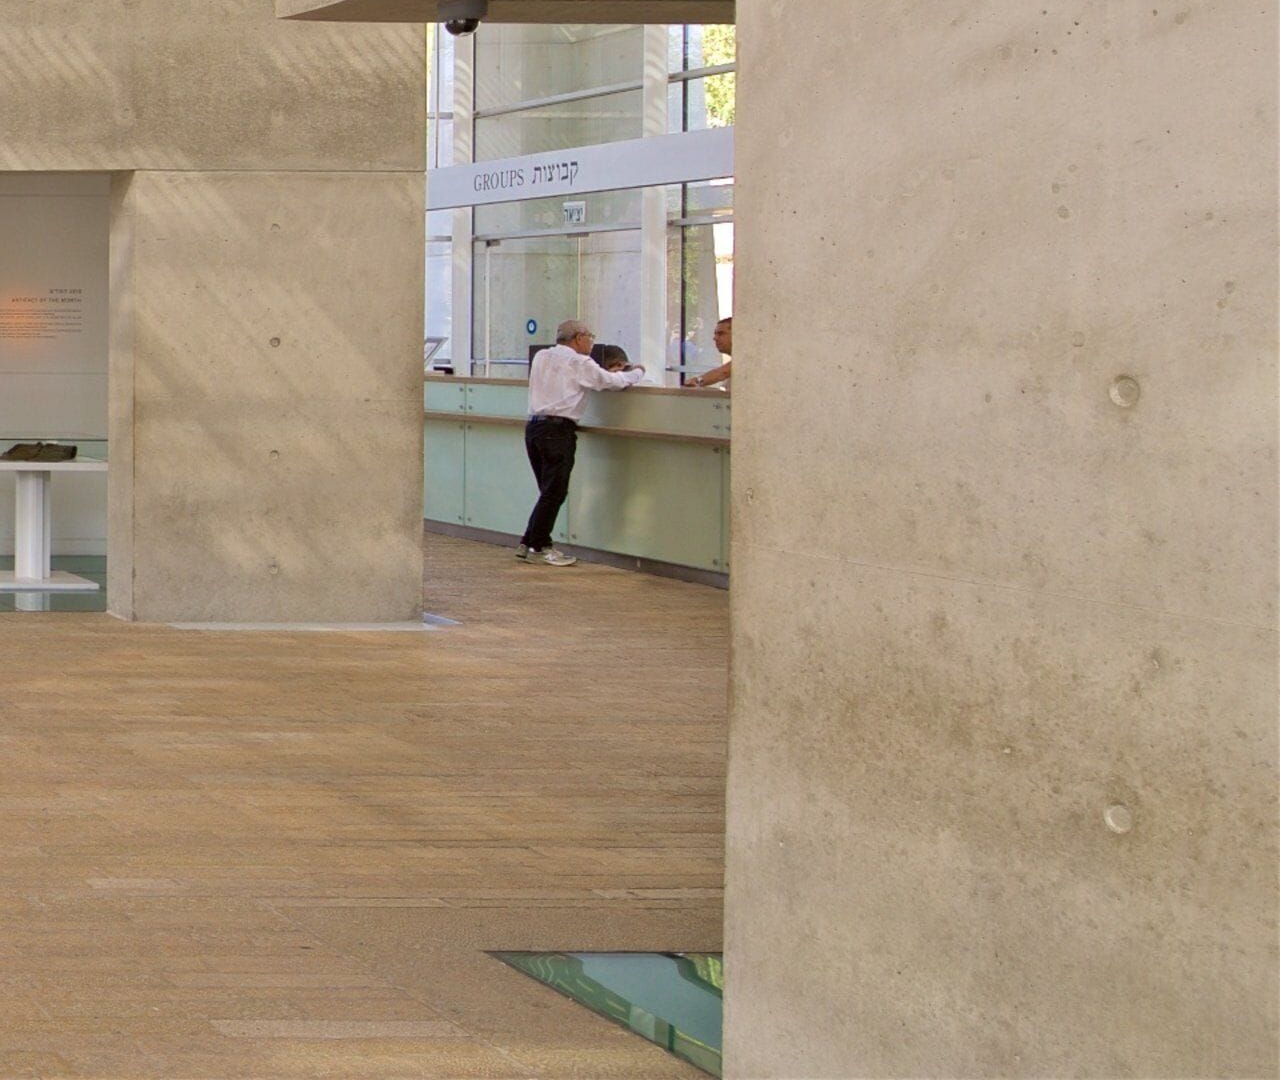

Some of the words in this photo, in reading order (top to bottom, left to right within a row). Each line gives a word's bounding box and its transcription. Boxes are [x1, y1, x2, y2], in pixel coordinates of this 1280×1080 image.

[474, 168, 525, 192] GROUPS
[532, 161, 579, 187] קבוצות
[564, 207, 583, 222] יציאה
